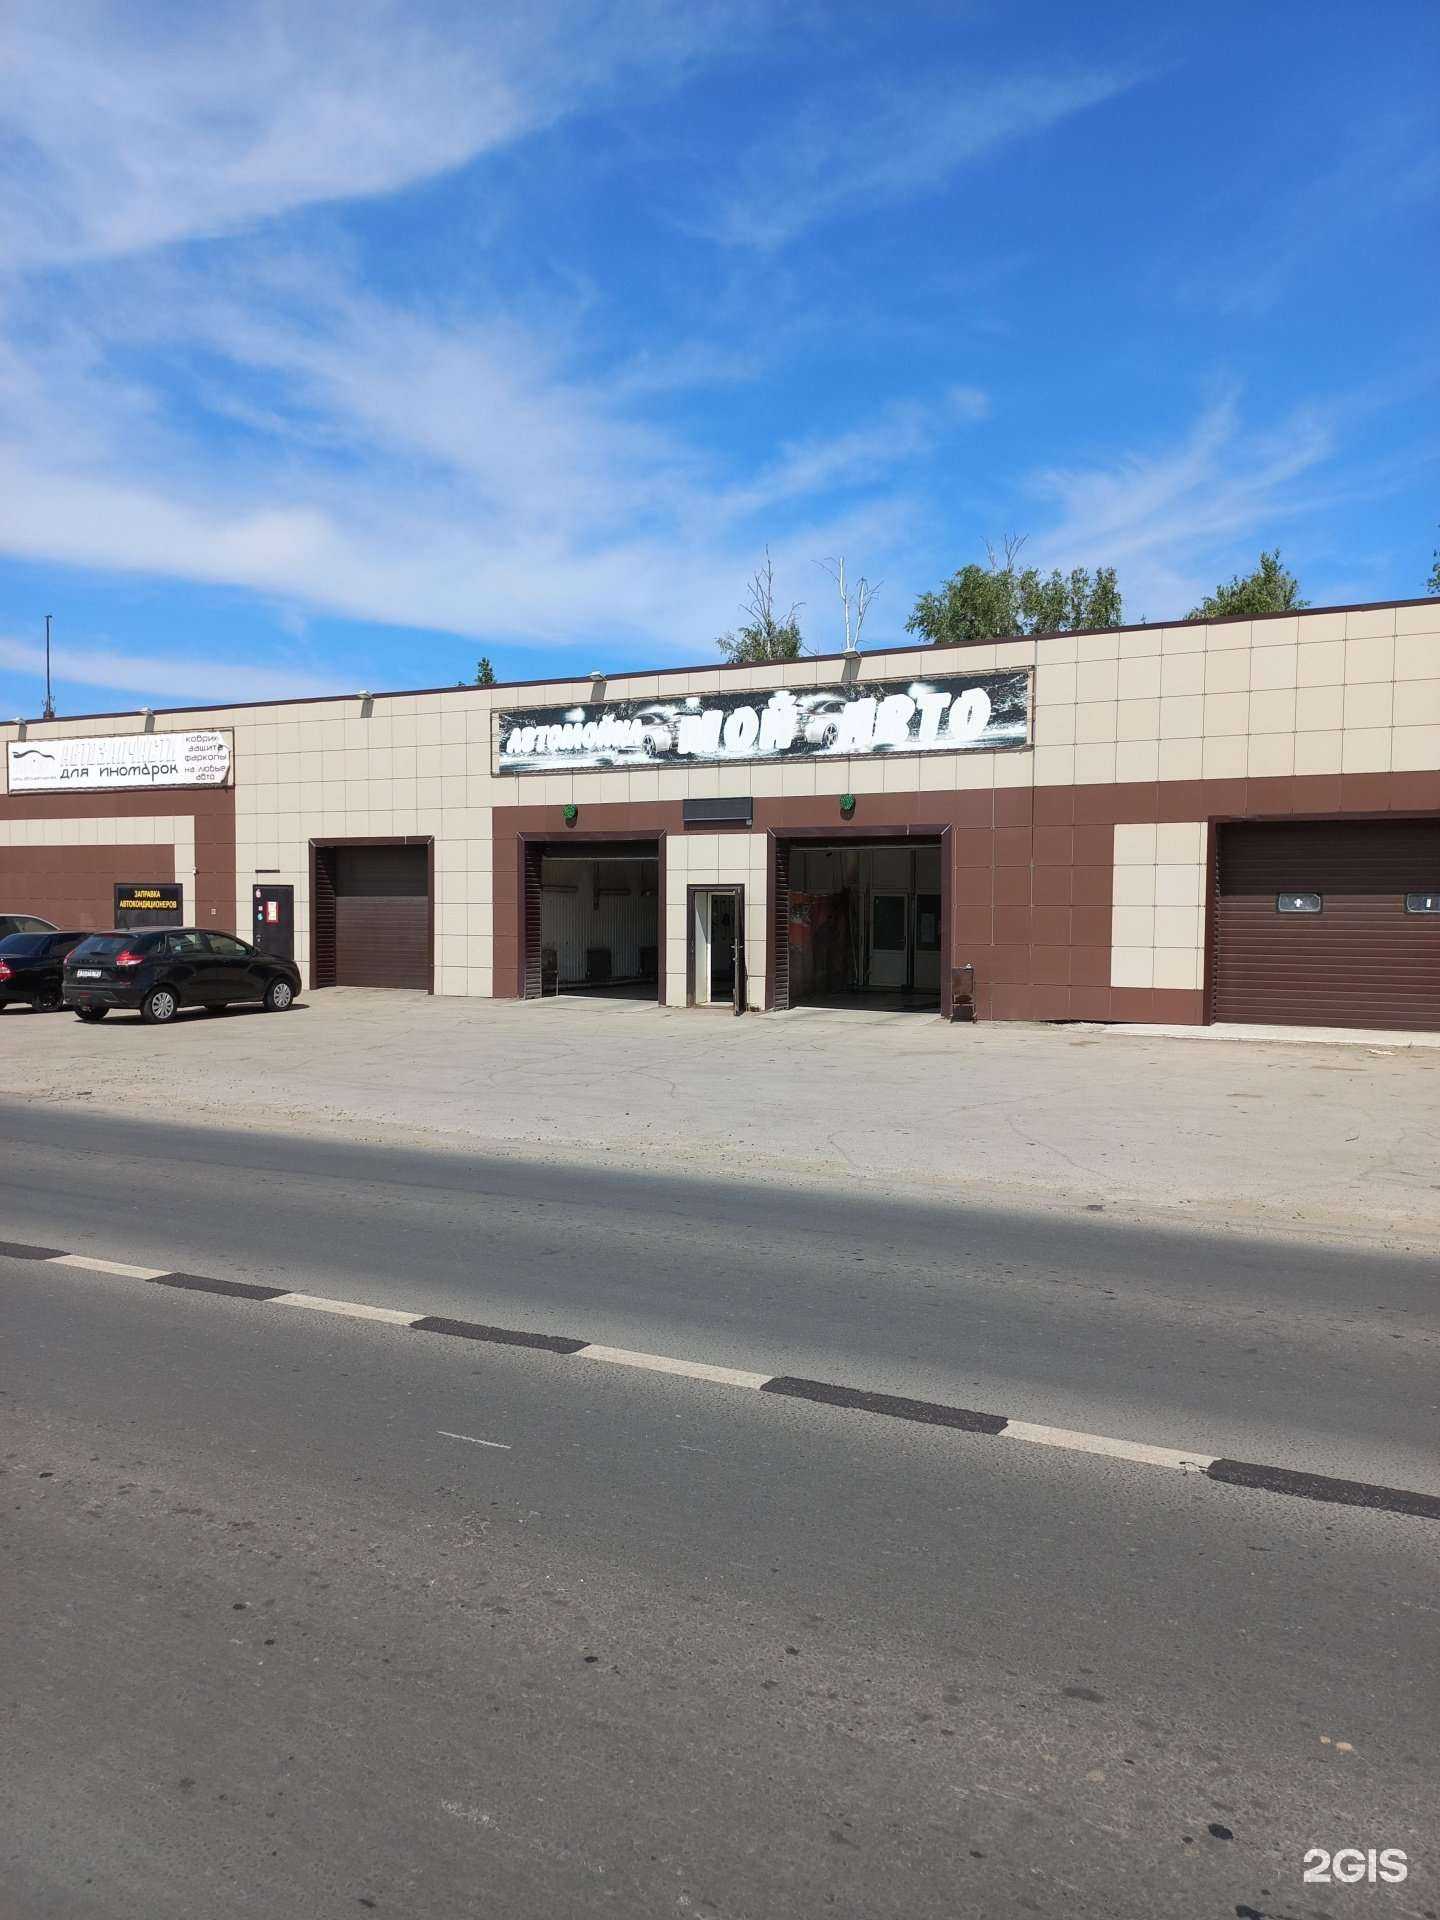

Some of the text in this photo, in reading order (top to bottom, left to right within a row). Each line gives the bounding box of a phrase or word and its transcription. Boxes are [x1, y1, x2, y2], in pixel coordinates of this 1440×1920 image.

[60, 763, 178, 782] для иномарок
[134, 890, 161, 898] ЗАПРАВКА
[119, 900, 177, 909] АВТОКОНДИЦИОНЕРОВ
